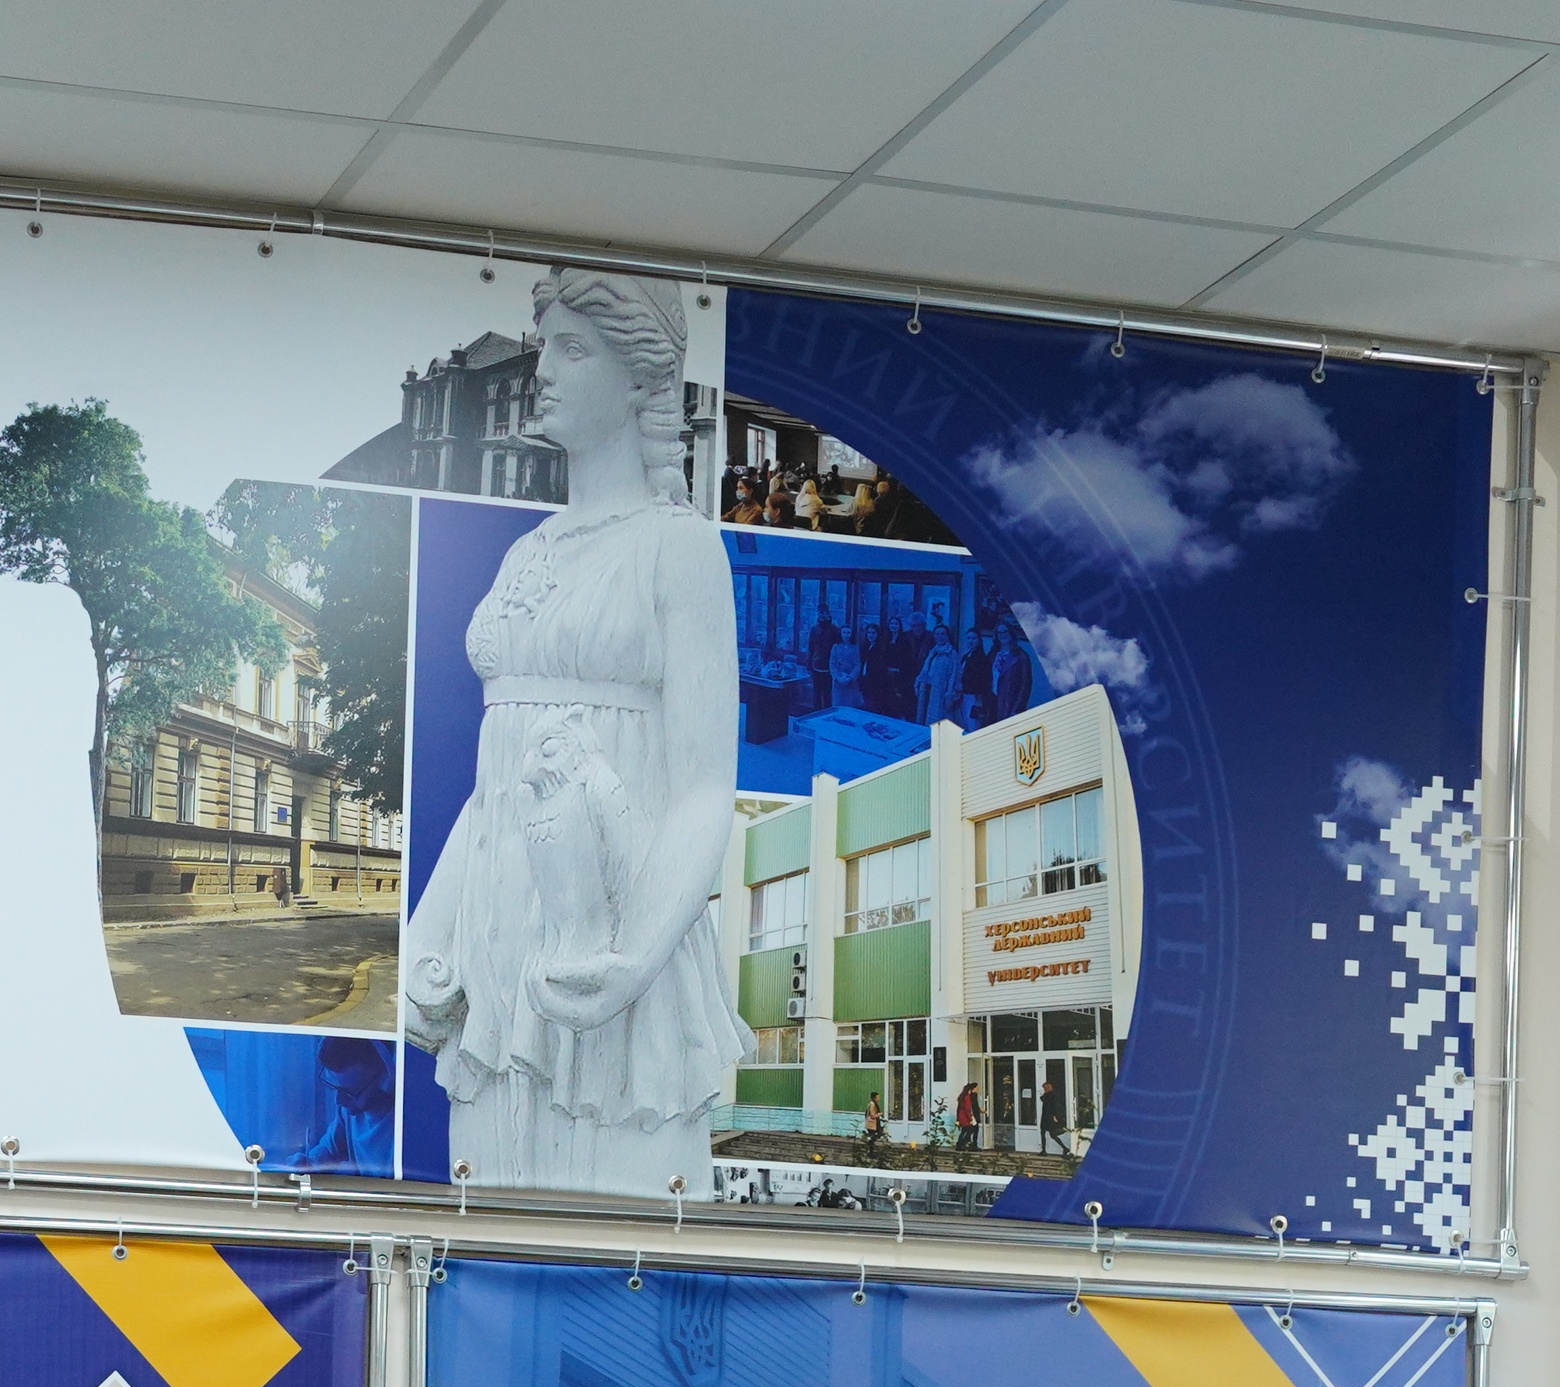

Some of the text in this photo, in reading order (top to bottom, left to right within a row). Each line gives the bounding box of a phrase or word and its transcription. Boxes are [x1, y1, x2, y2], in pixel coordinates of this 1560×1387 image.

[984, 906, 1092, 940] ХЕРСОНСЬКИЙ
[992, 925, 1085, 953] ДЕРЖАВНИЙ
[986, 959, 1091, 987] УНІВЕРСИТЕТ
